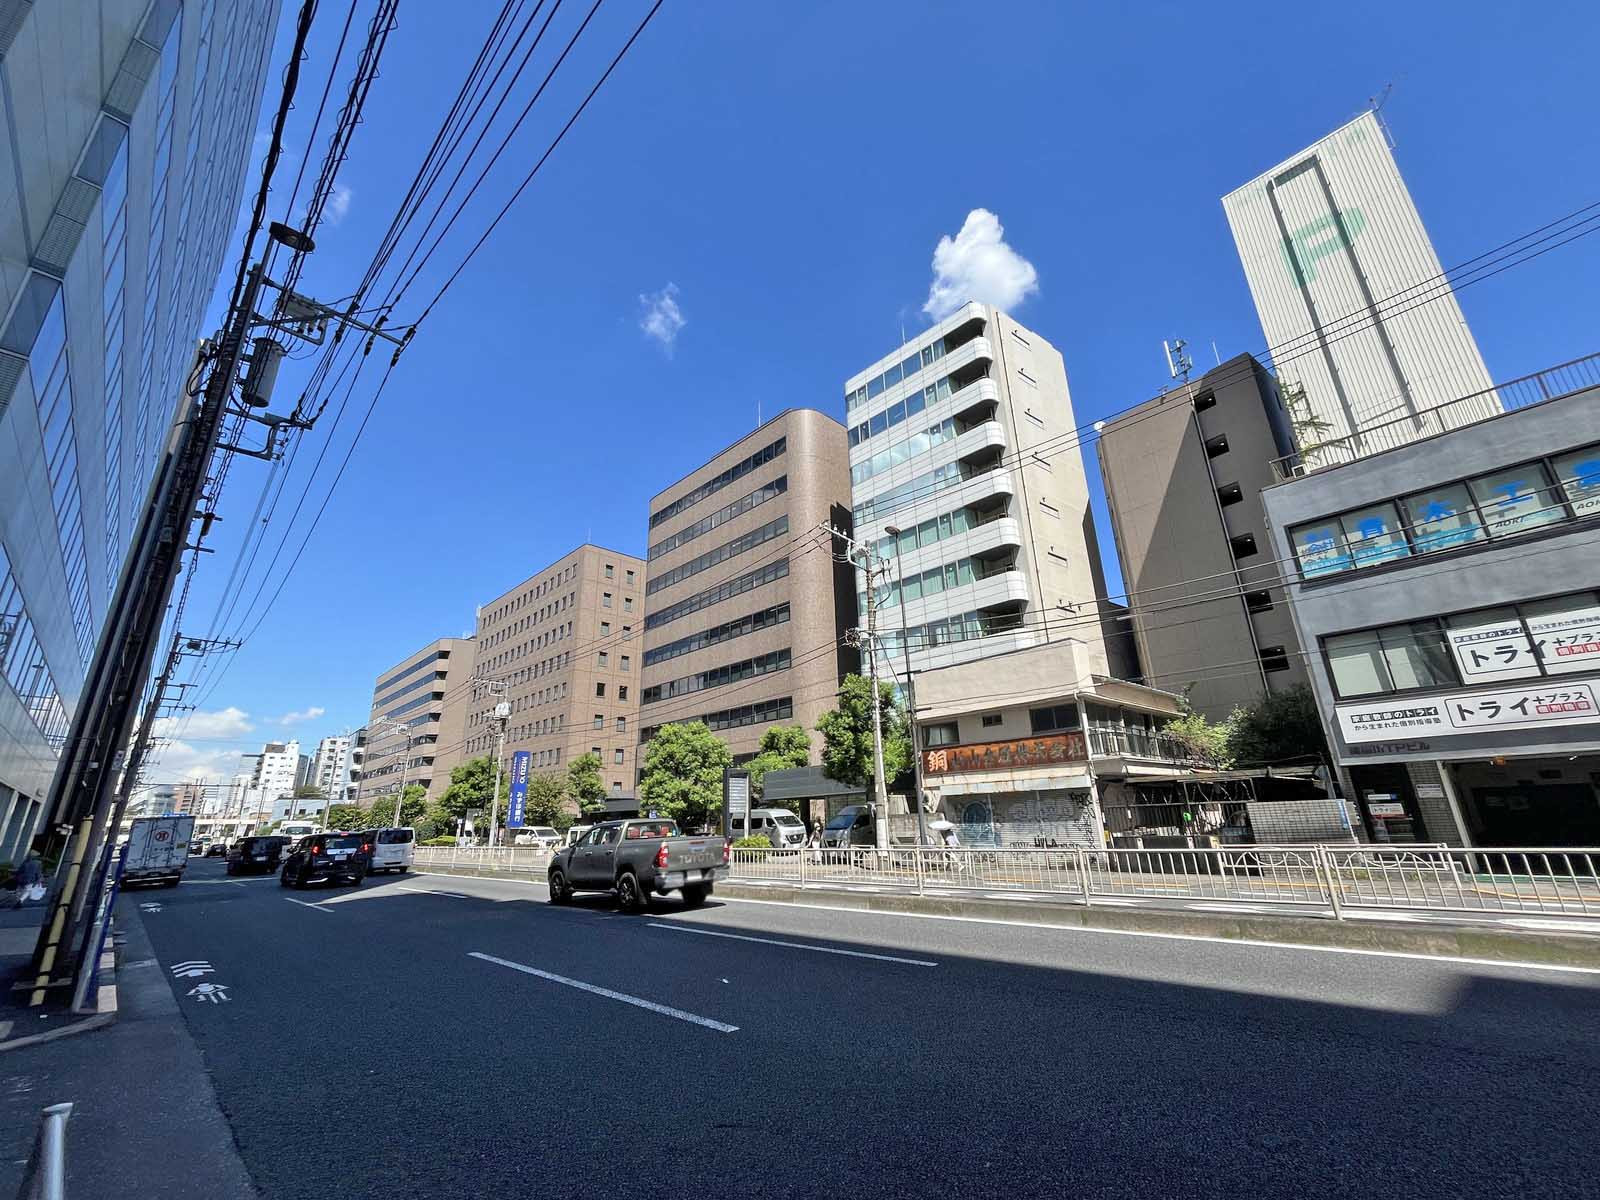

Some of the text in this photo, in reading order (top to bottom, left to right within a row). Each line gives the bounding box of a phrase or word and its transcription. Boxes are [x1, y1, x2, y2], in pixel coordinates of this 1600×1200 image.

[1279, 207, 1367, 288] P
[1470, 631, 1600, 668] トライ +プラ
[1456, 696, 1529, 722] トライ
[927, 750, 948, 772] 銅
[680, 852, 716, 865] TOYOTA
